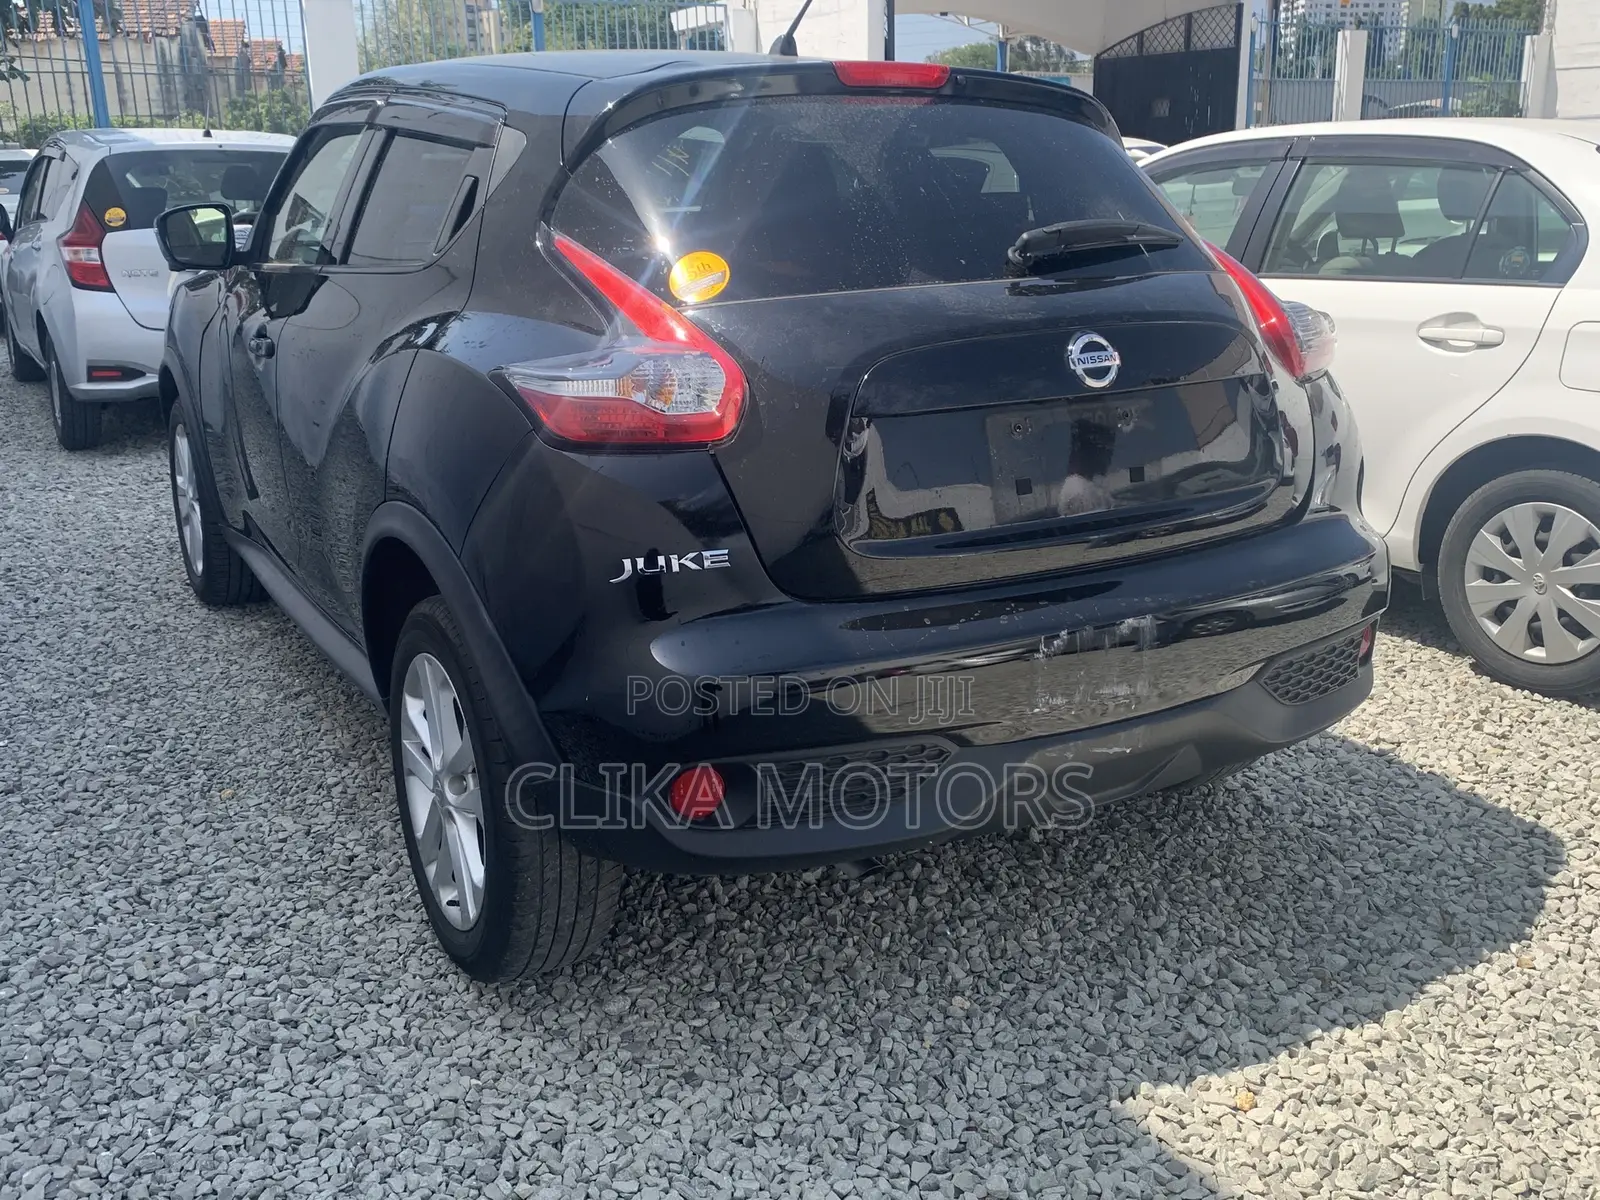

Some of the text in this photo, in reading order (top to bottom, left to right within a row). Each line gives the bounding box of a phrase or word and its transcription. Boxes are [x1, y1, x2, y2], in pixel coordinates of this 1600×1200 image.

[121, 268, 159, 279] NOTE
[1077, 354, 1117, 366] NISSAN
[609, 549, 731, 584] JUKE
